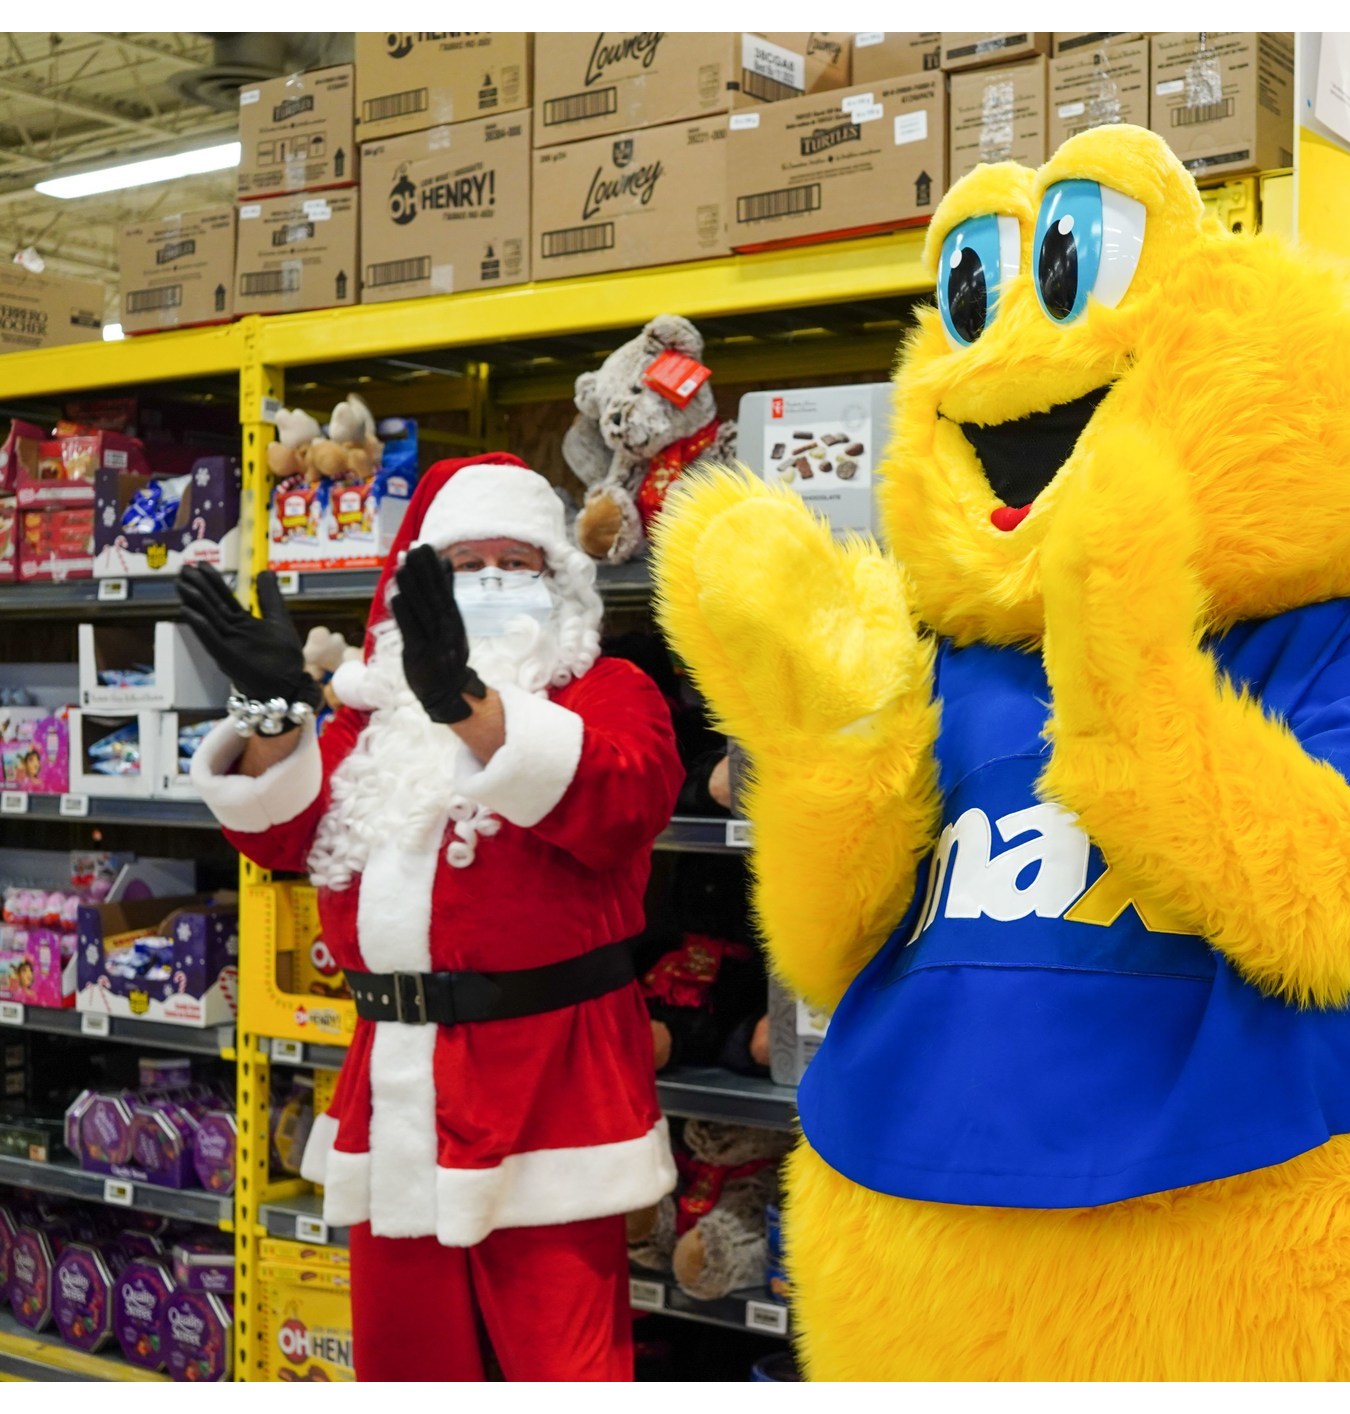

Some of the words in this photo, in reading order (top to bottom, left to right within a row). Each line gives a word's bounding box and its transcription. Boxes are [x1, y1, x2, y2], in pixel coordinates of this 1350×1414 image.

[584, 32, 666, 87] Lowney
[802, 124, 861, 155] TURTLES
[421, 170, 496, 210] HENRY!
[582, 160, 666, 221] Lowney
[905, 801, 1206, 947] max
[278, 1326, 310, 1356] OH
[312, 1335, 352, 1368] HEN
